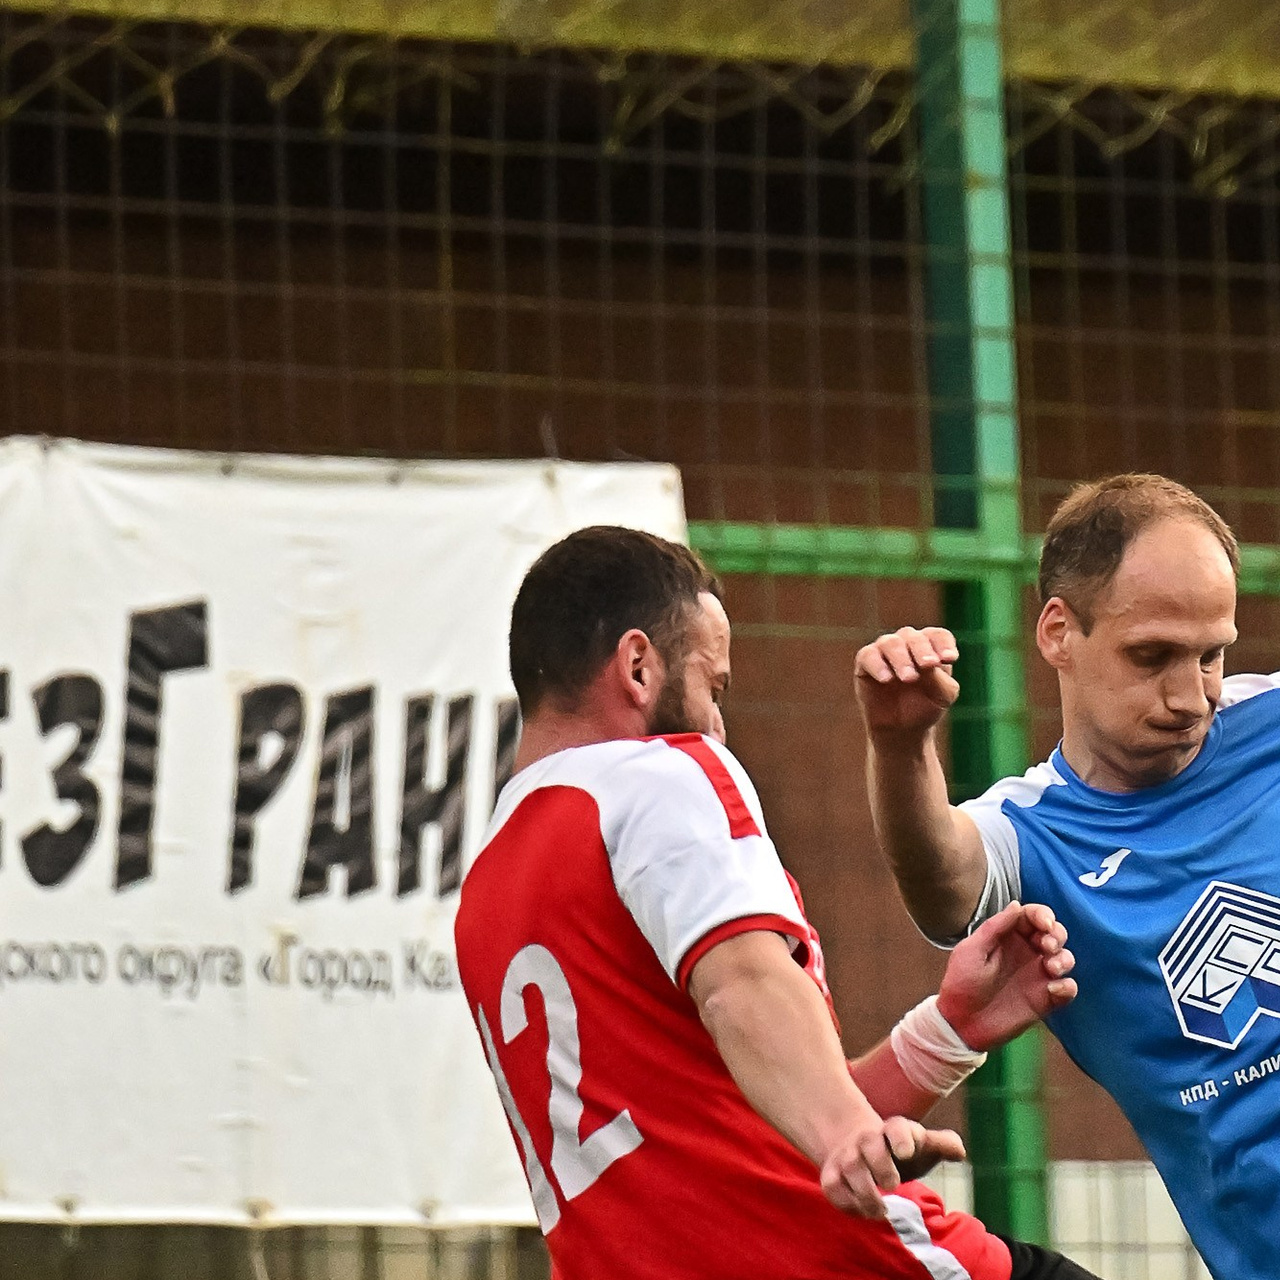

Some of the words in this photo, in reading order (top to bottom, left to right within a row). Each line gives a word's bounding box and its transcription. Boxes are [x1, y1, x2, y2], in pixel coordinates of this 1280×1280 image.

[0, 597, 521, 901] ЗГРАН
[0, 939, 106, 986] ского
[117, 941, 242, 1000] округа
[405, 937, 458, 990] Ка
[1179, 1082, 1218, 1106] КПД
